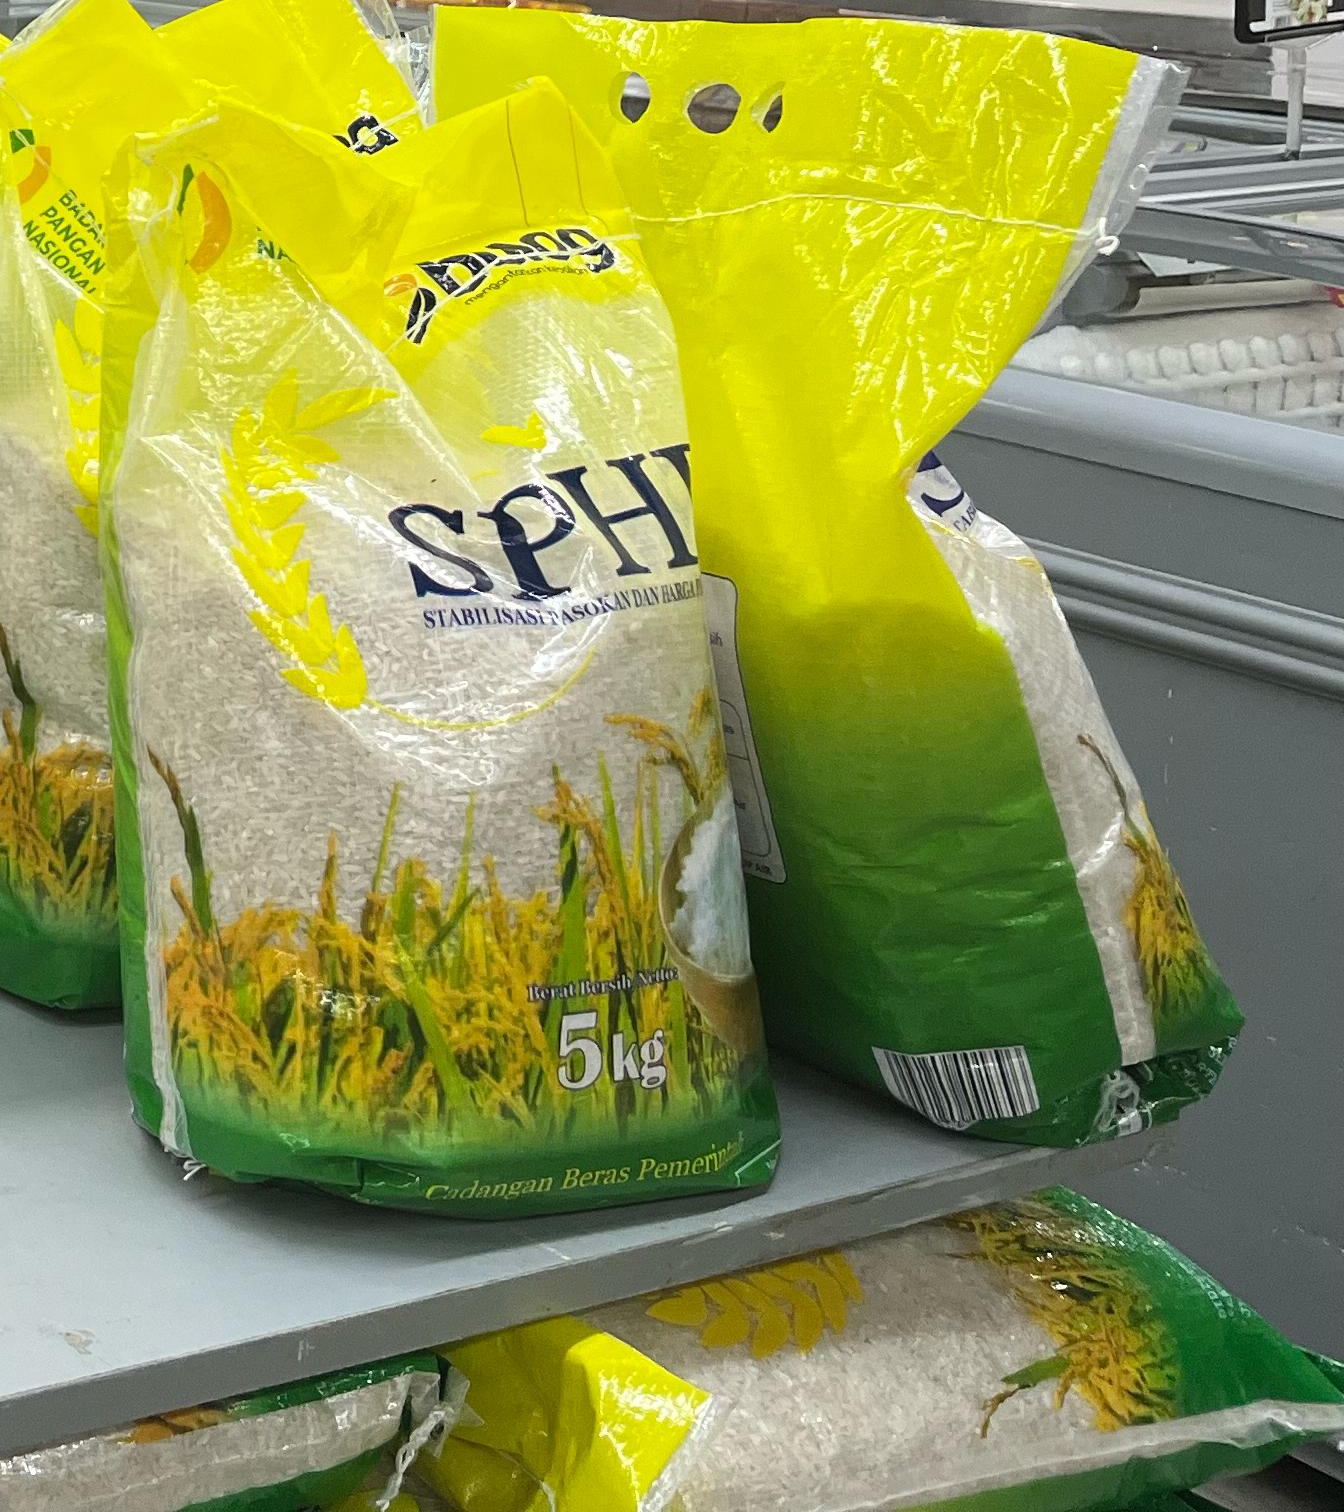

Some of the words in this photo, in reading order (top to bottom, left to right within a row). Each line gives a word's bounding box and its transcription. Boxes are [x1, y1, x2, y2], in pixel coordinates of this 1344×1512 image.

[40, 205, 105, 275] PANGAN
[423, 607, 548, 629] STABILISASI
[634, 588, 660, 608] DAN
[527, 981, 577, 1004] Berat
[556, 1009, 604, 1090] 5
[611, 1027, 668, 1090] kg
[425, 1172, 554, 1202] Cadangan
[560, 1164, 630, 1190] Beras
[637, 1131, 746, 1182] Pemerintah
